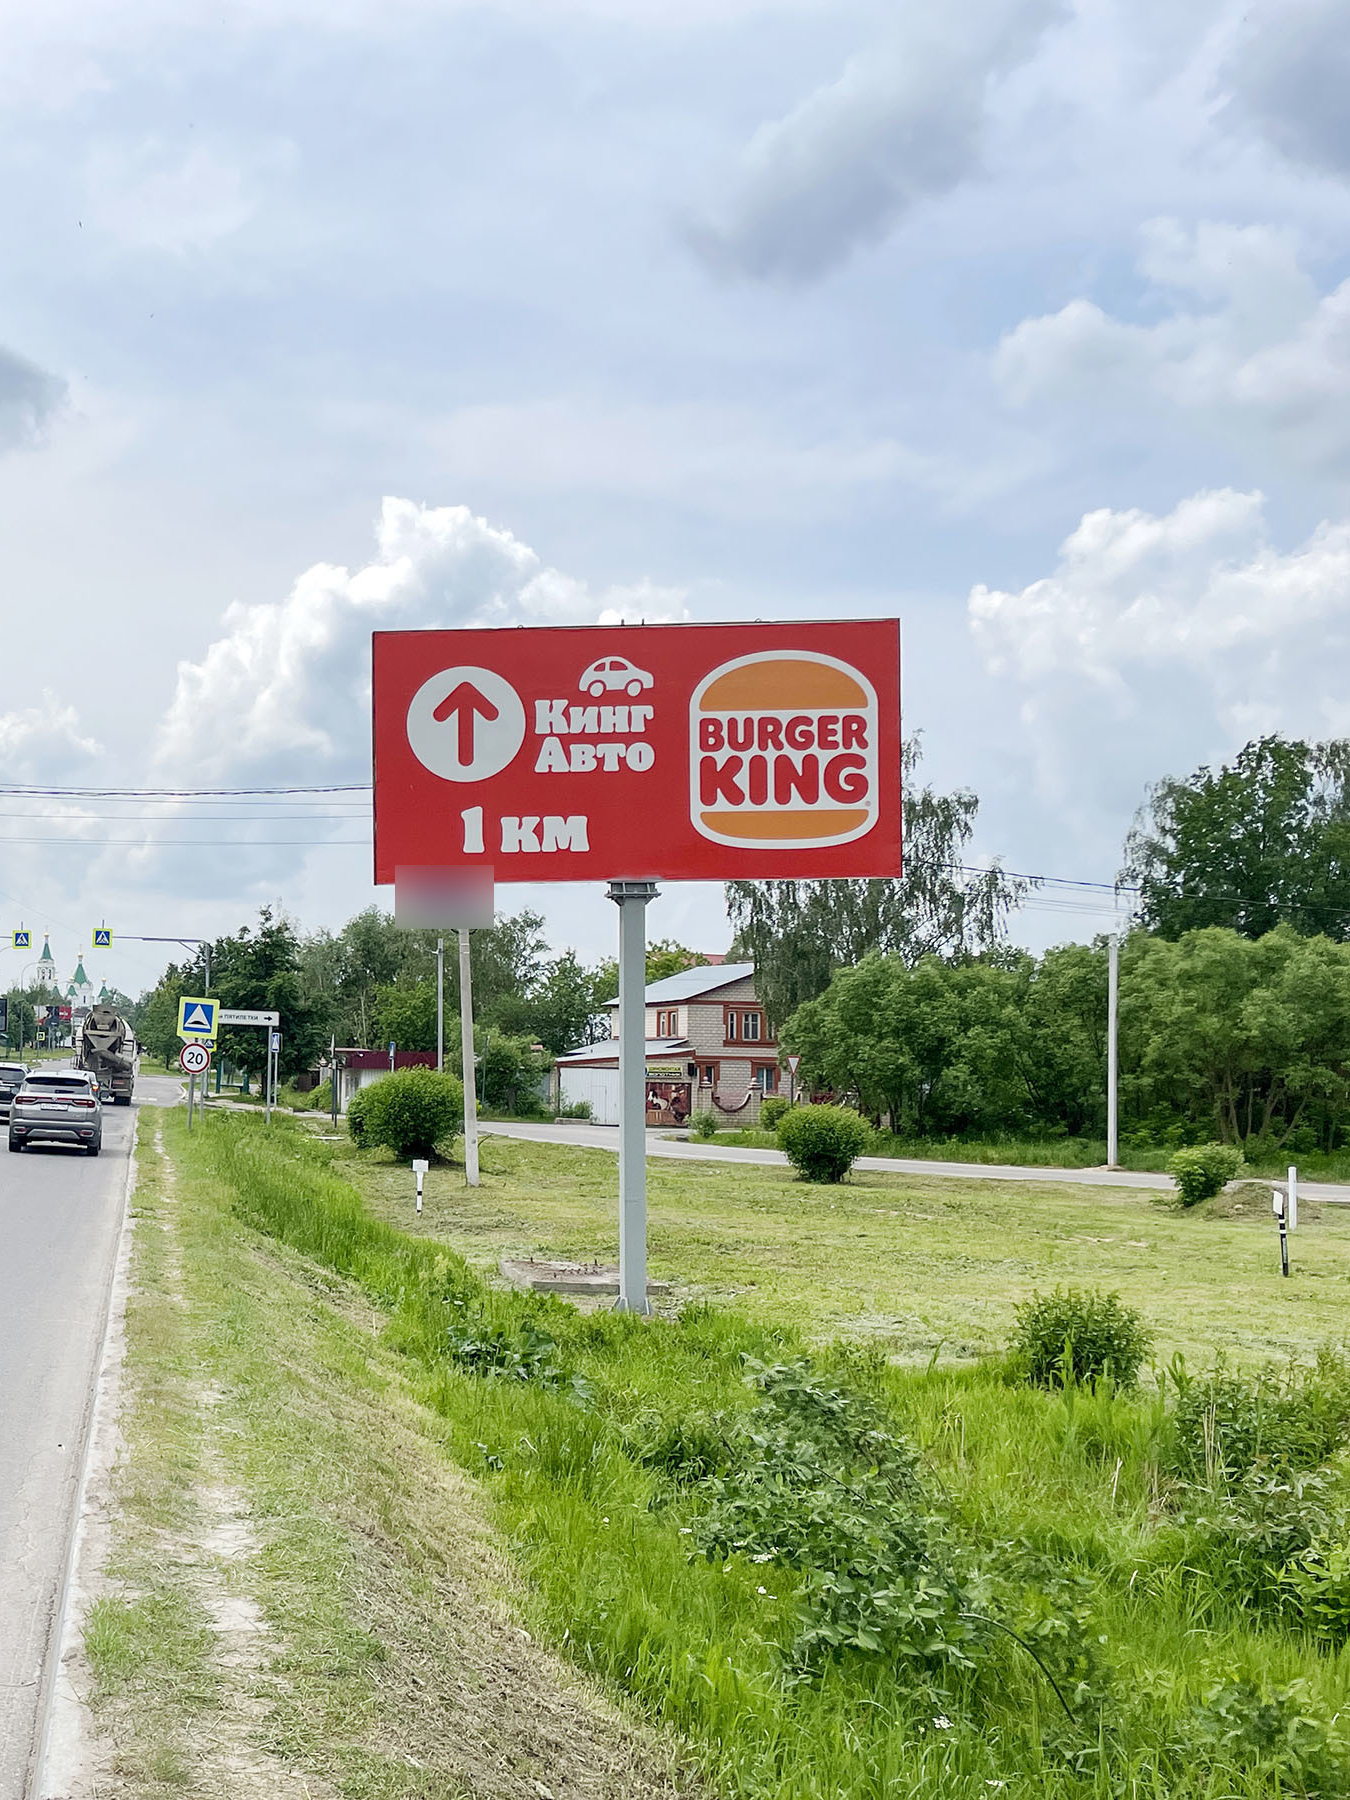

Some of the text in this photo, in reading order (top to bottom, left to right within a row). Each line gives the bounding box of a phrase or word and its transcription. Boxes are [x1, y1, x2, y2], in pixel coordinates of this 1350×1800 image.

[534, 699, 654, 734] Кинг
[699, 714, 869, 752] BURGER
[534, 736, 655, 774] Авто
[698, 752, 869, 807] KING
[461, 806, 485, 854] 1
[224, 1013, 259, 1021] ПЯТИЛЕТКИ
[186, 1052, 204, 1065] 20
